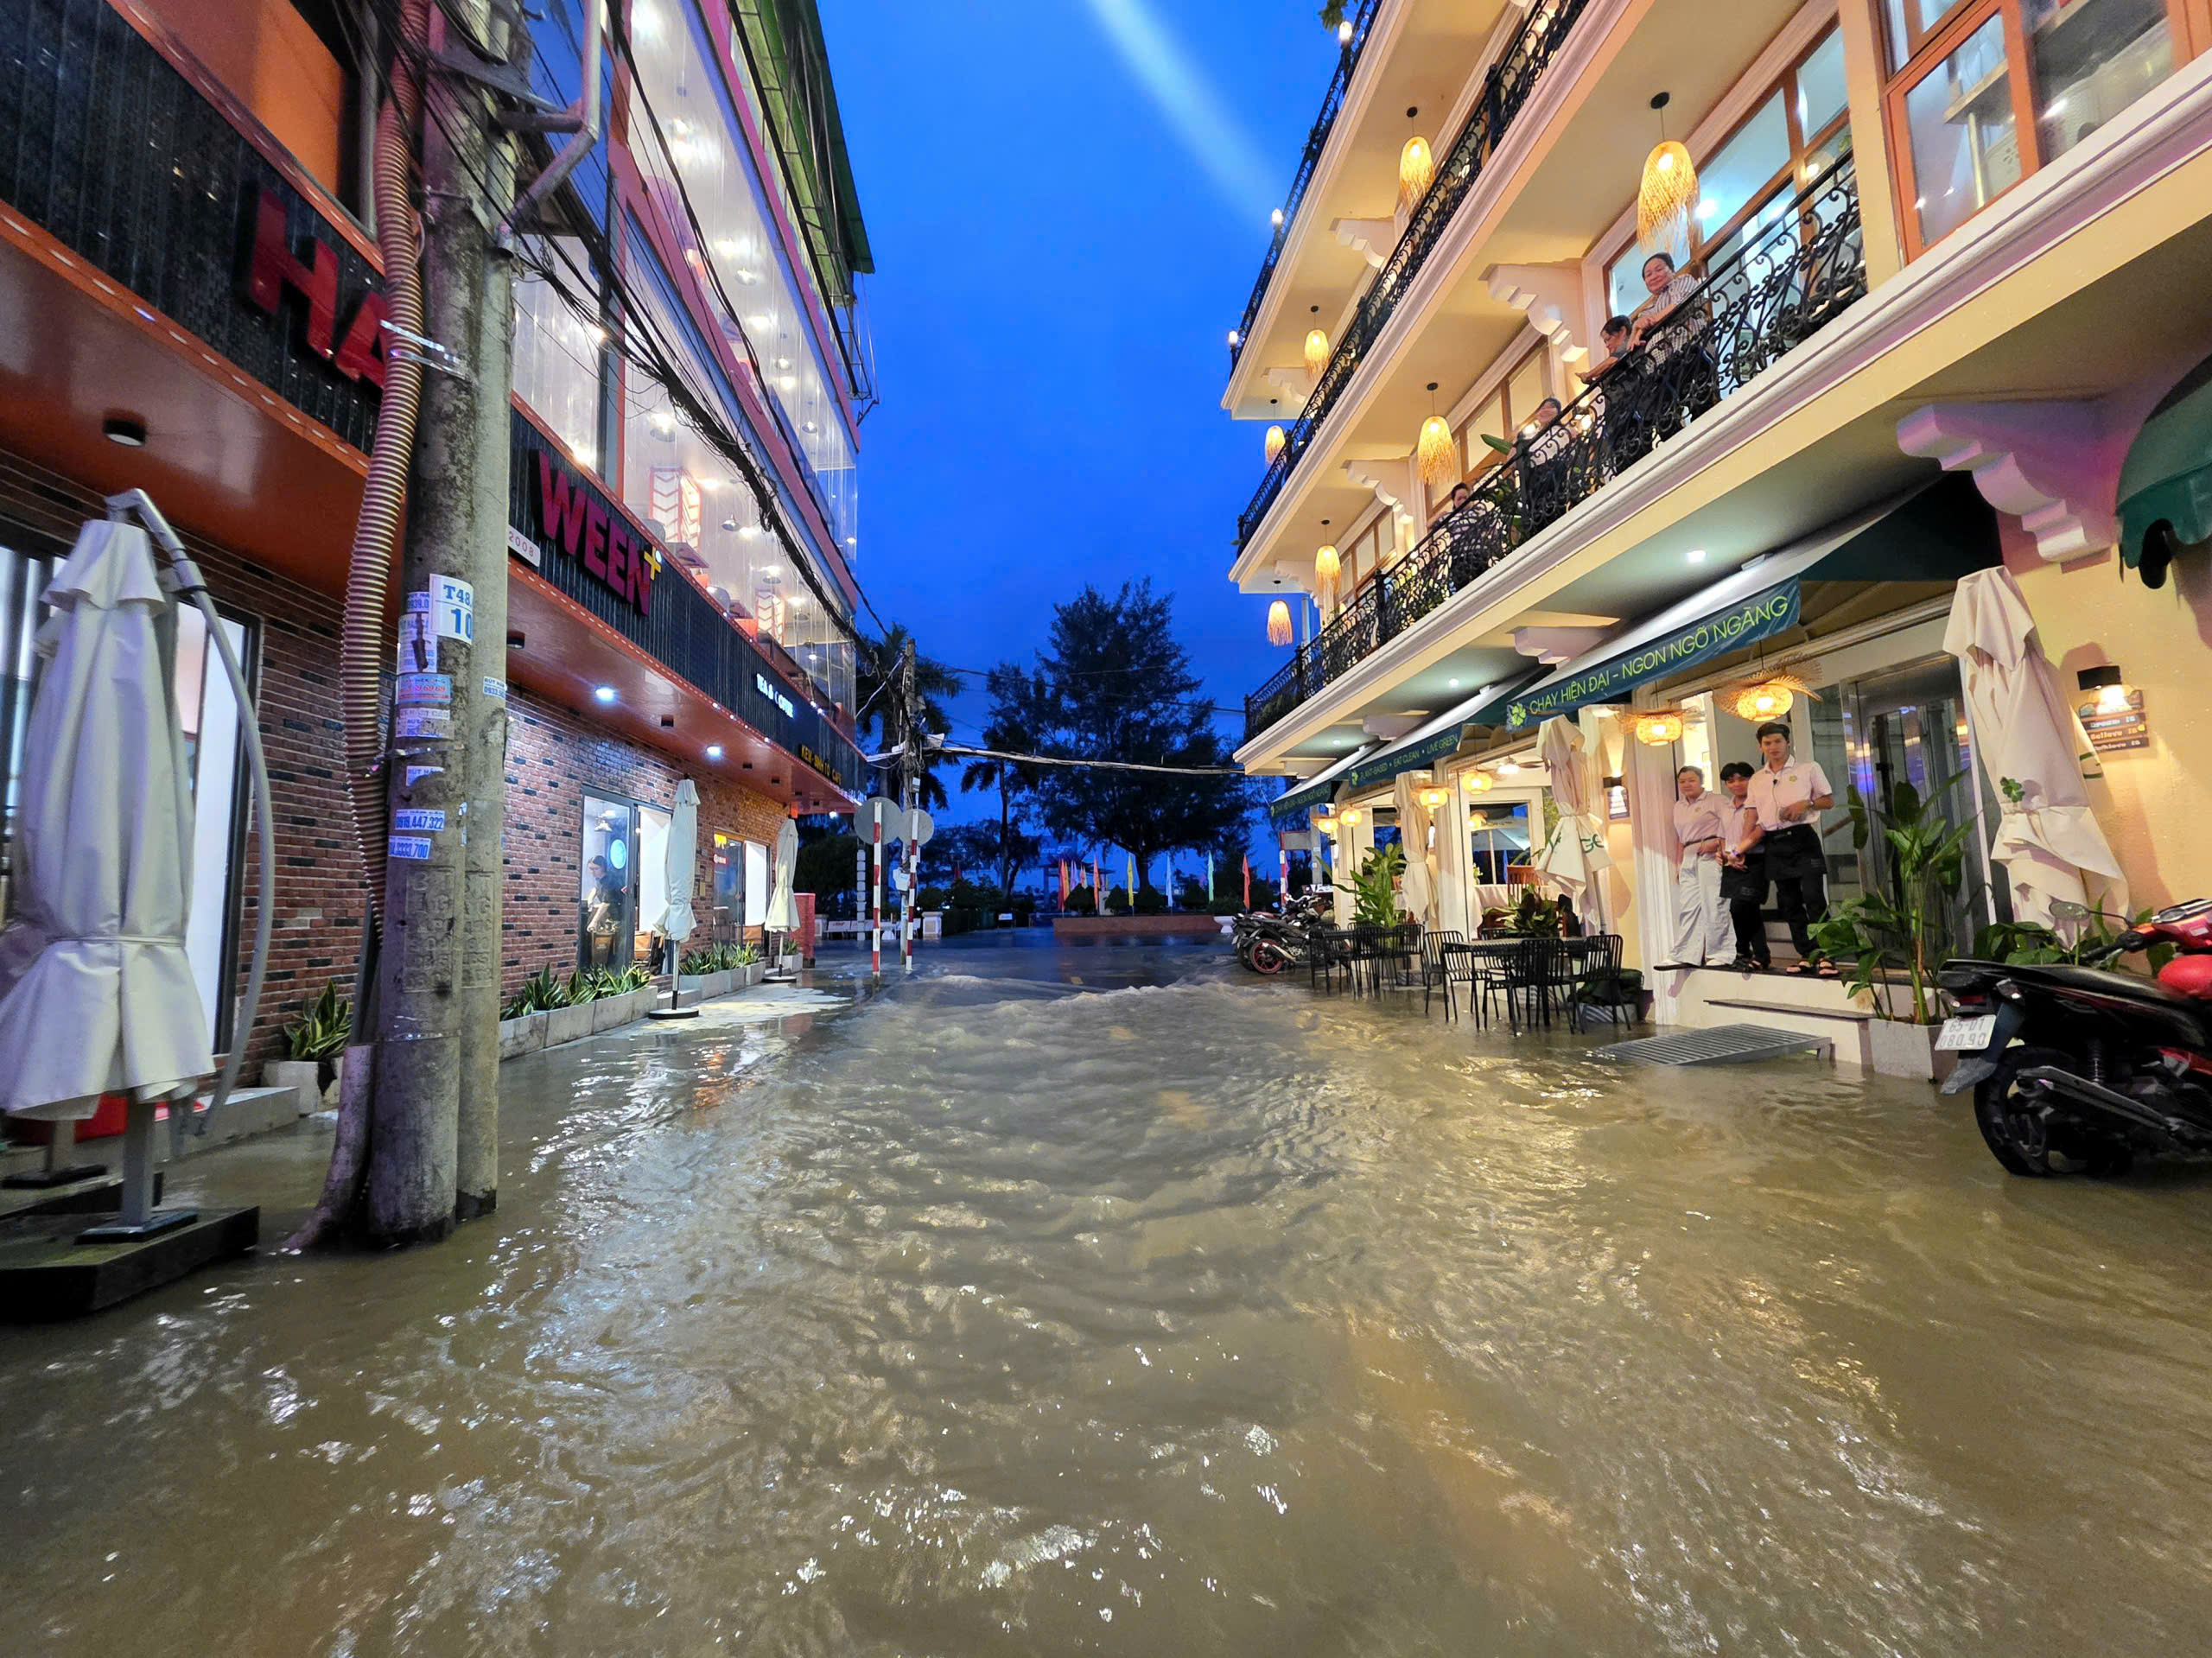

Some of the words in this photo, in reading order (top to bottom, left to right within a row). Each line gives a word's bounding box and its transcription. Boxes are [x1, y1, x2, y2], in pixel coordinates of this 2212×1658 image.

[508, 530, 535, 558] 2008
[1529, 693, 1558, 715] CHAY
[1560, 680, 1586, 703] HIỆN
[1588, 670, 1610, 694] ĐẠI
[1622, 646, 1666, 679] NGON
